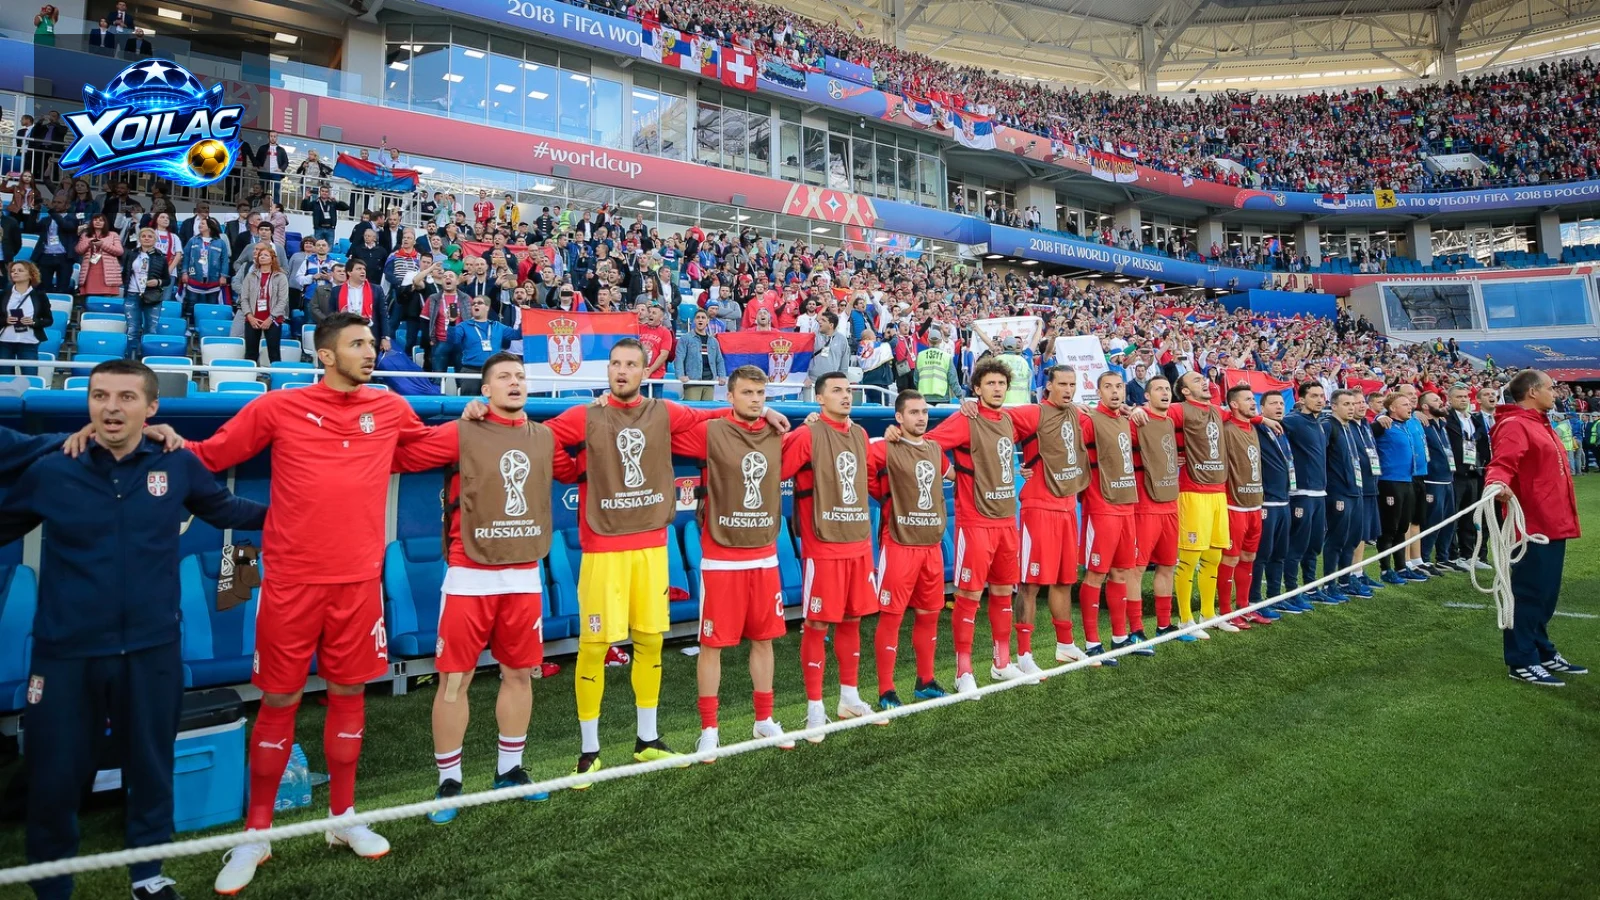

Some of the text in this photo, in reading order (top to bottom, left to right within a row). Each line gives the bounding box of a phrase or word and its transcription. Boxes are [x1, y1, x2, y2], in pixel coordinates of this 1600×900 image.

[507, 0, 642, 48] 2018 FIFA WO
[533, 141, 642, 179] #worldcup
[1313, 198, 1373, 208] ЧЕОНАТ
[1411, 198, 1425, 207] ПО
[1428, 195, 1481, 207] ФУТБОЛУ
[1484, 193, 1509, 203] FIFA
[1515, 190, 1540, 200] 2018
[1543, 190, 1552, 199] В
[1029, 238, 1163, 273] 2018 FIFA WORLD CUP RUSSIA
[570, 494, 578, 503] FI
[601, 492, 664, 509] RUSSIA 2018
[718, 515, 774, 528] RUSSIA 208
[822, 511, 868, 522] RUSSIA 208
[897, 515, 930, 526] RUSSIA
[475, 525, 542, 539] RUSSIA 208
[370, 616, 387, 652] 16
